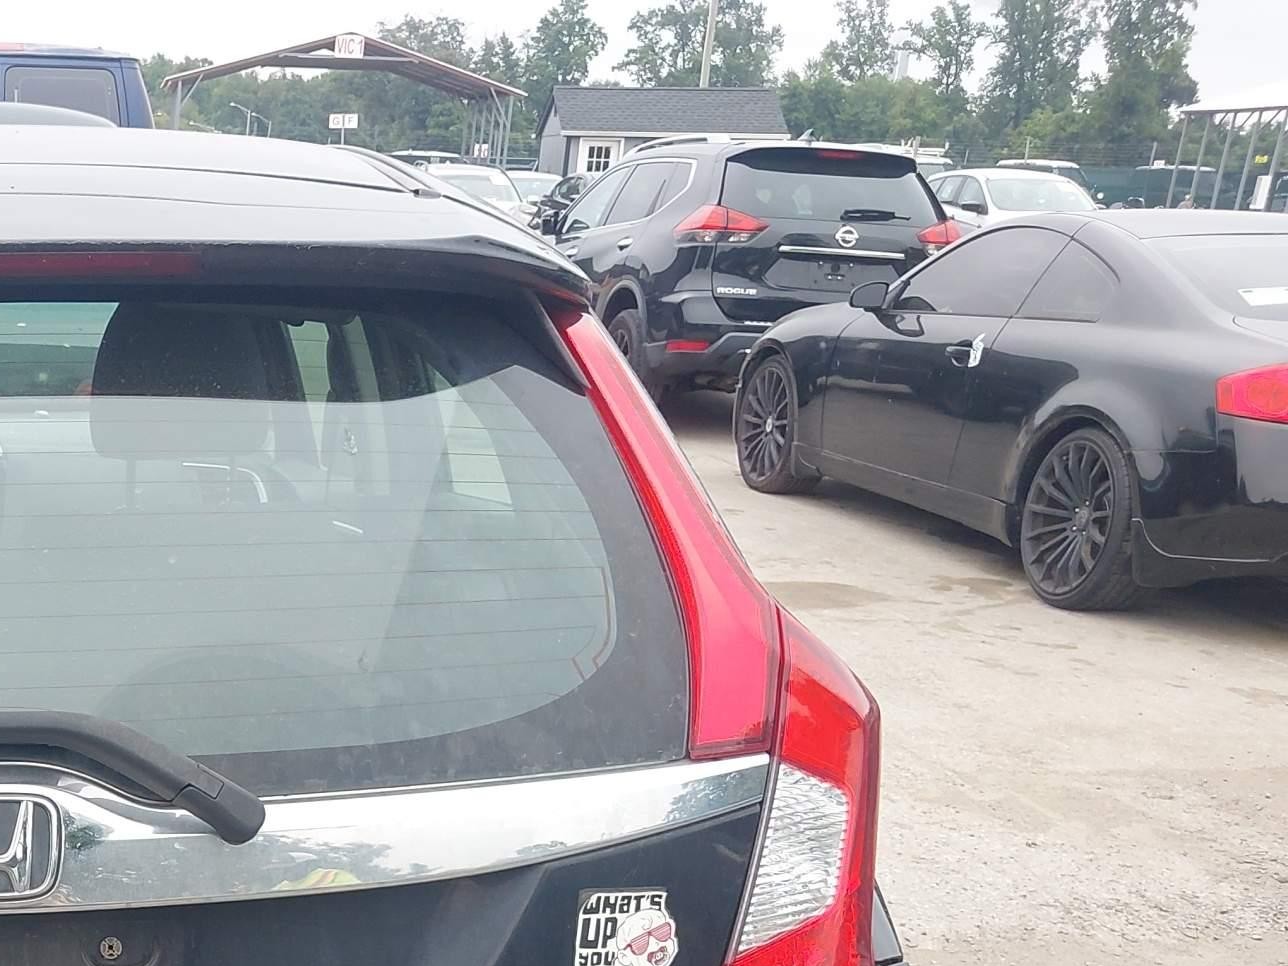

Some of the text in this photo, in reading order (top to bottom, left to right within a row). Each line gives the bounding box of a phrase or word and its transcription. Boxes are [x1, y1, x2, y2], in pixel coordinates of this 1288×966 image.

[337, 38, 364, 54] VIC 1
[716, 287, 757, 296] ROGUE
[579, 917, 618, 949] UP
